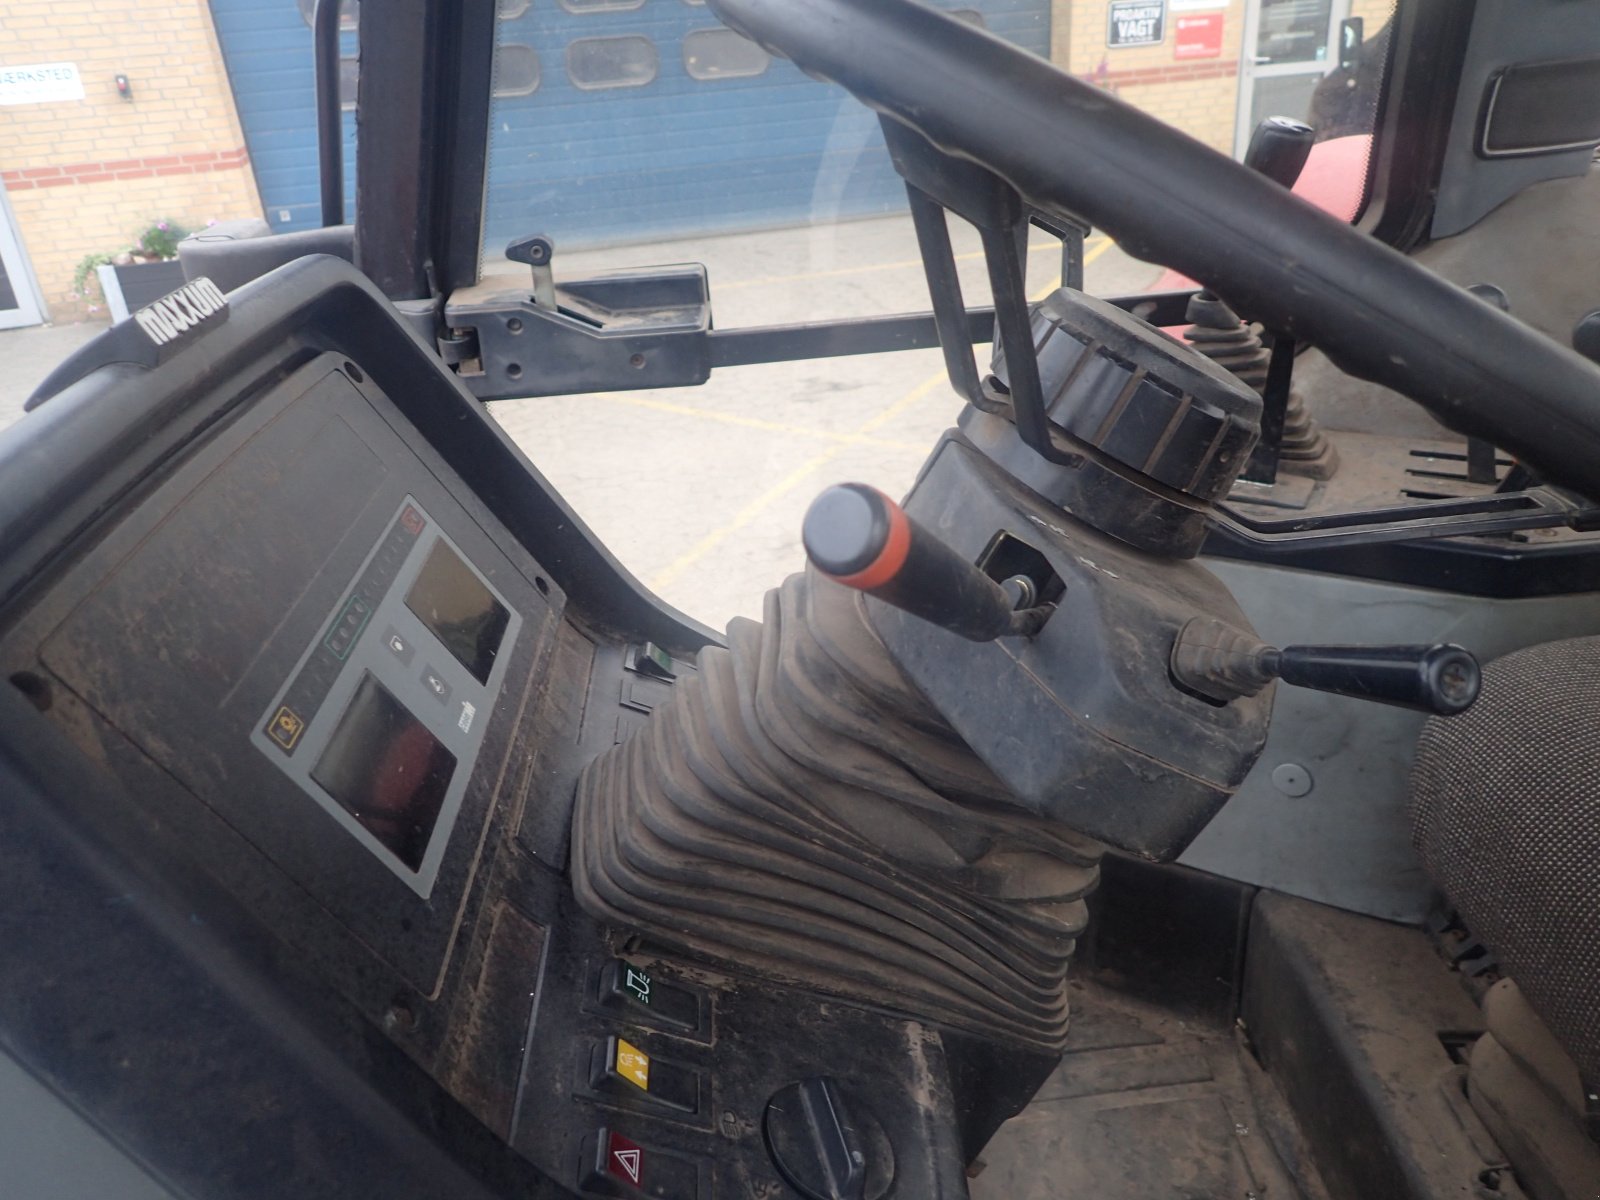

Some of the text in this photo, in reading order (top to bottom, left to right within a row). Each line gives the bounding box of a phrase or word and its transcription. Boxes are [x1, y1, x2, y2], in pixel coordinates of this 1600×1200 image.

[1118, 19, 1156, 37] VAGT
[0, 68, 73, 84] ÆRKSTED
[134, 276, 228, 345] MAXXUM
